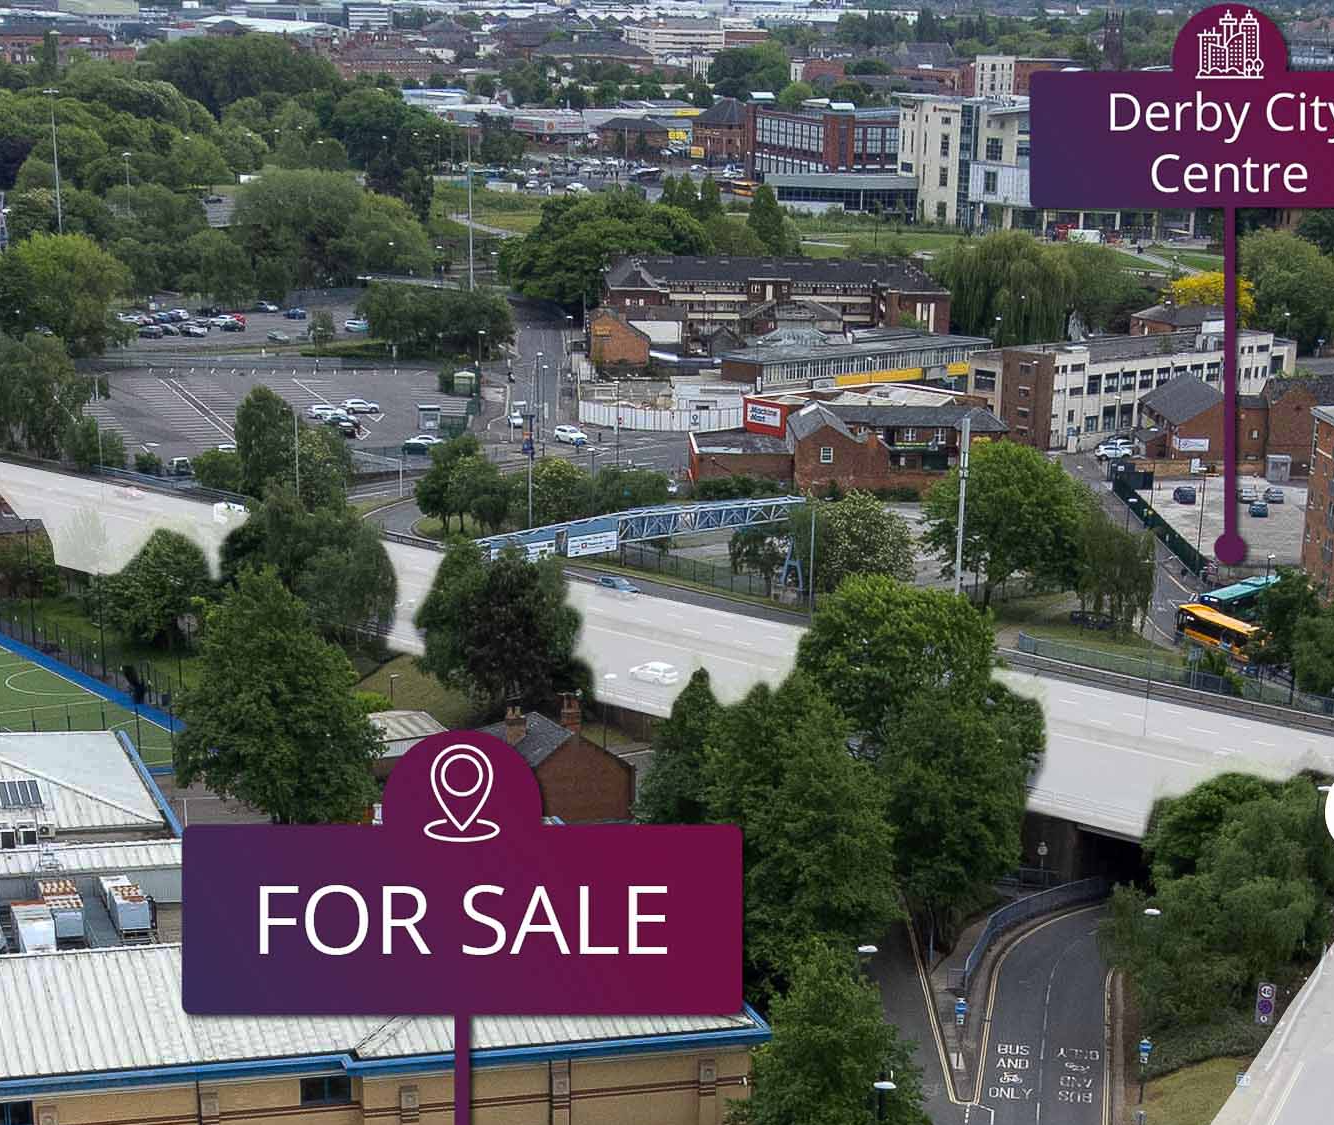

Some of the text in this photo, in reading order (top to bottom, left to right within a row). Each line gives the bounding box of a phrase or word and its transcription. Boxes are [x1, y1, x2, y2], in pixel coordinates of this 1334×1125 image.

[997, 1043, 1030, 1056] BUS
[996, 1057, 1029, 1069] AND
[988, 1086, 1034, 1100] ONLY
